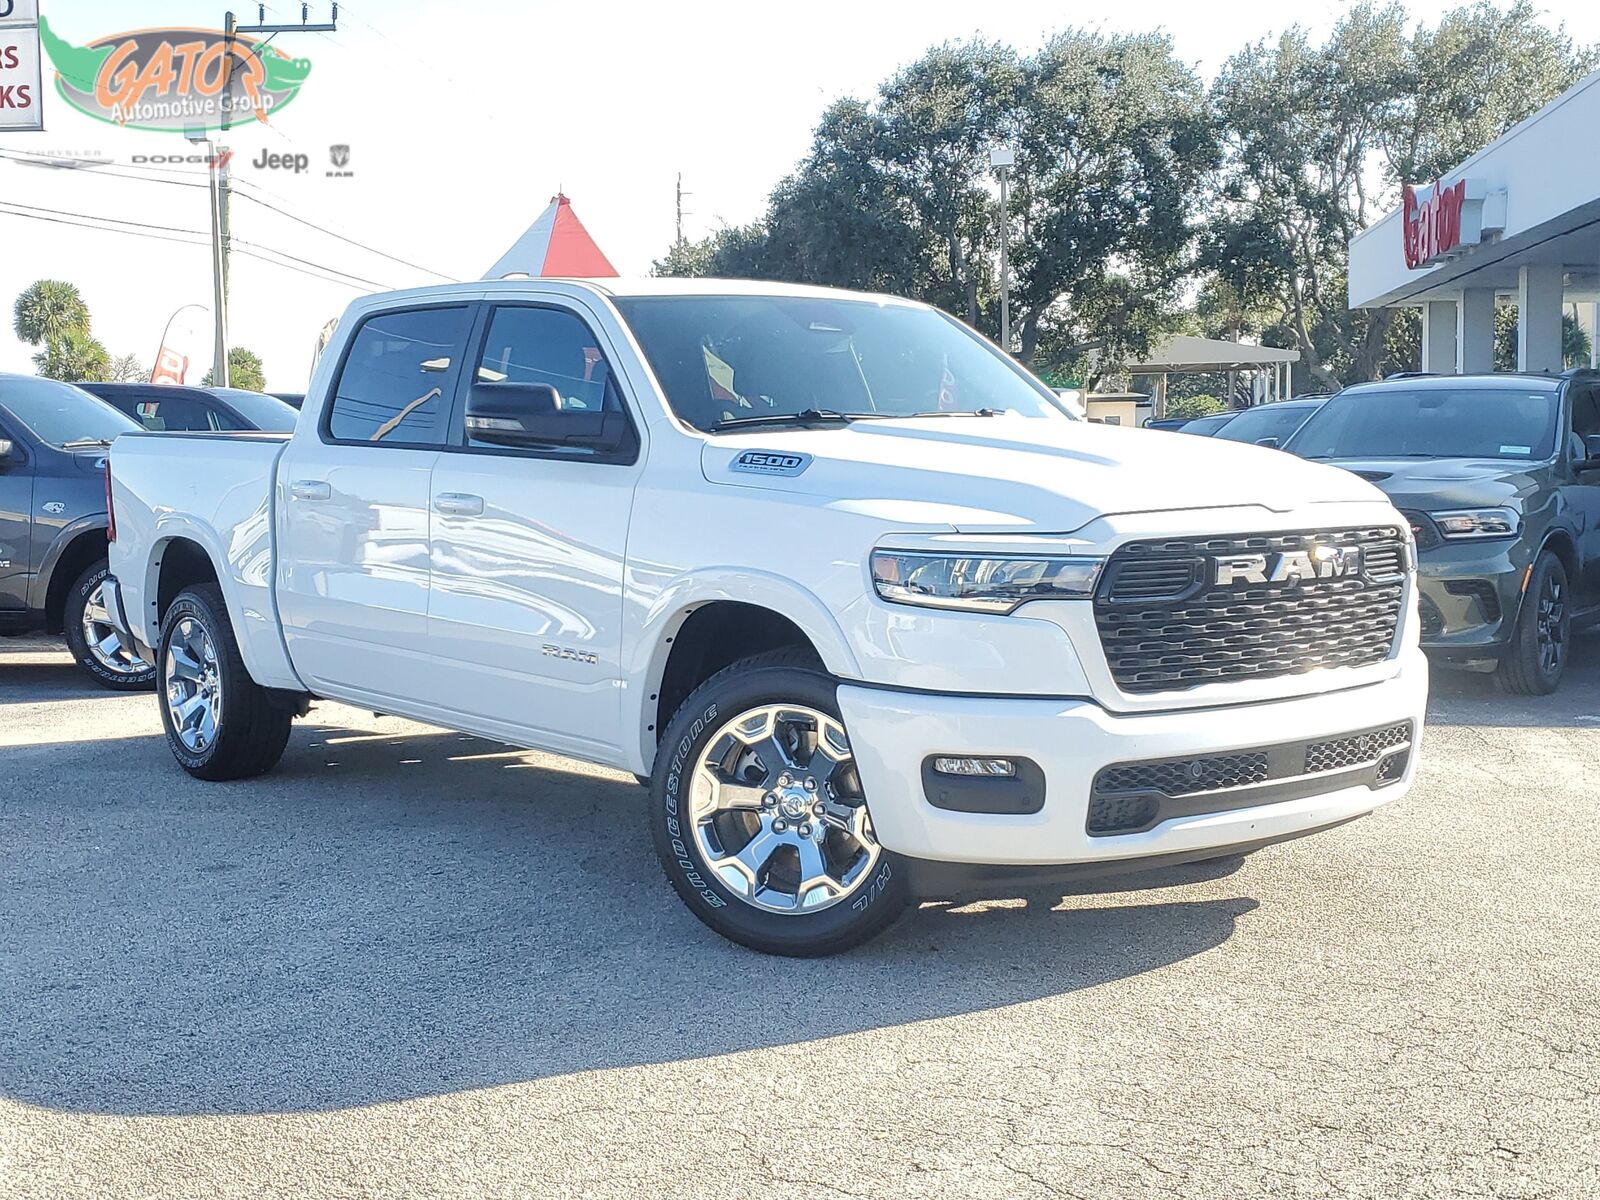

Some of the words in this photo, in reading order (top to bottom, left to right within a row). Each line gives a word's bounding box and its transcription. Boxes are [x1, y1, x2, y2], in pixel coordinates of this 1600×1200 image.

[1403, 178, 1466, 270] Gator
[743, 454, 800, 467] 1500
[1214, 548, 1360, 586] RAM
[541, 643, 599, 665] RAM
[665, 703, 729, 909] BRIDGESTONE
